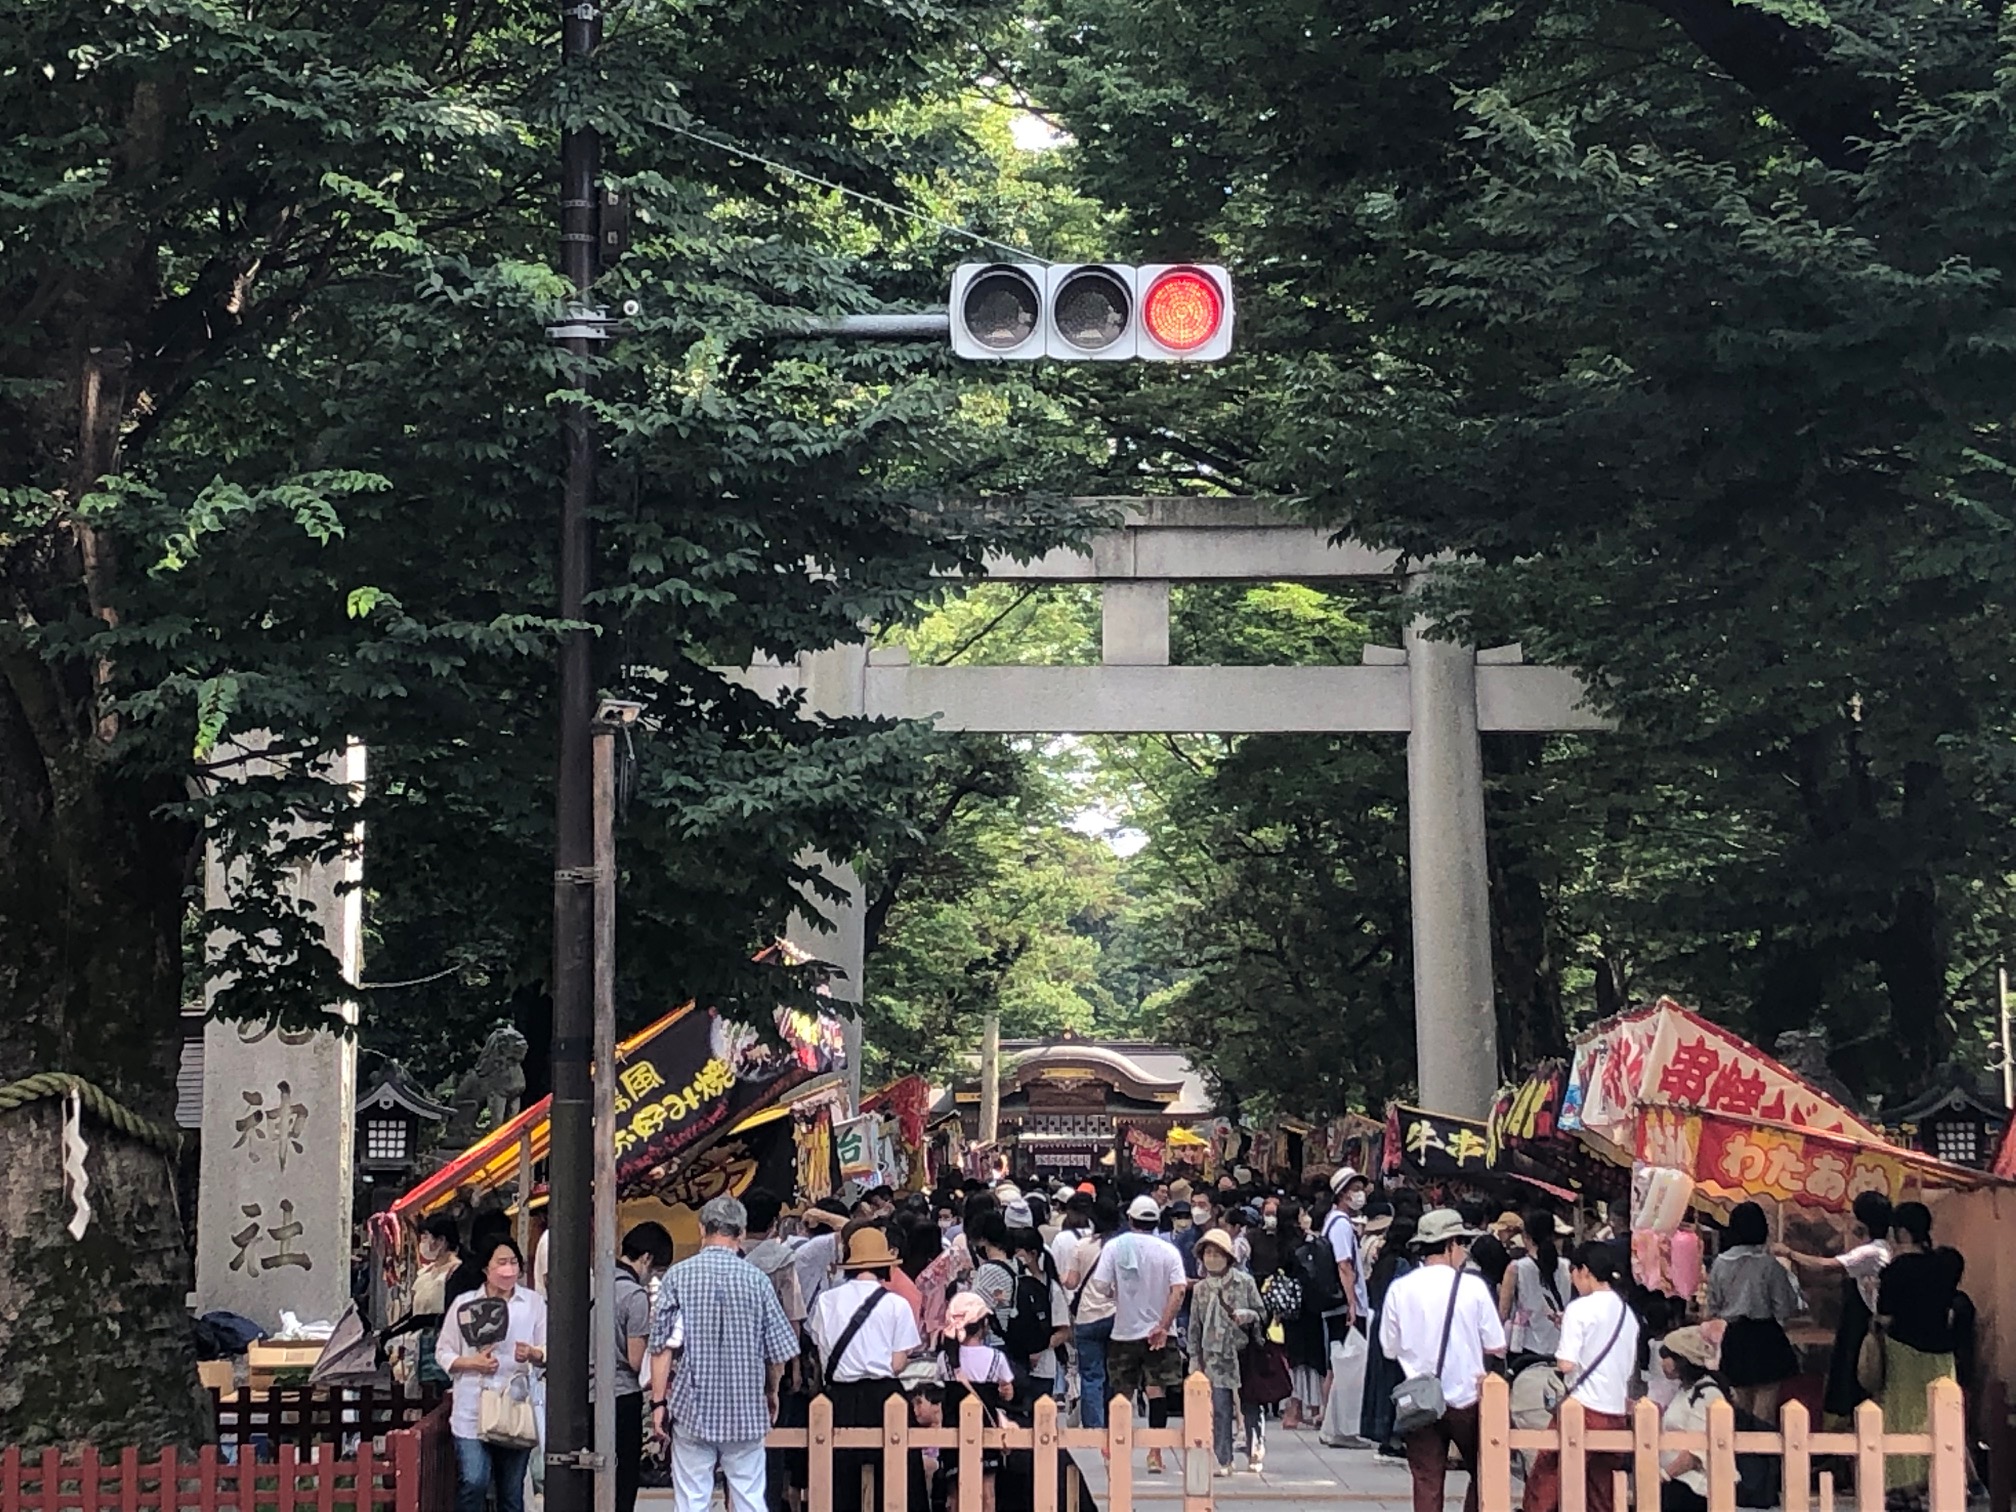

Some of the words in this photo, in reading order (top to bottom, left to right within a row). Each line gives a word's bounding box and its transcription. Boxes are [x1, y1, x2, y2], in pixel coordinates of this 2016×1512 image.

[230, 1011, 313, 1278] 神社
[1720, 1133, 1889, 1202] わたあめ
